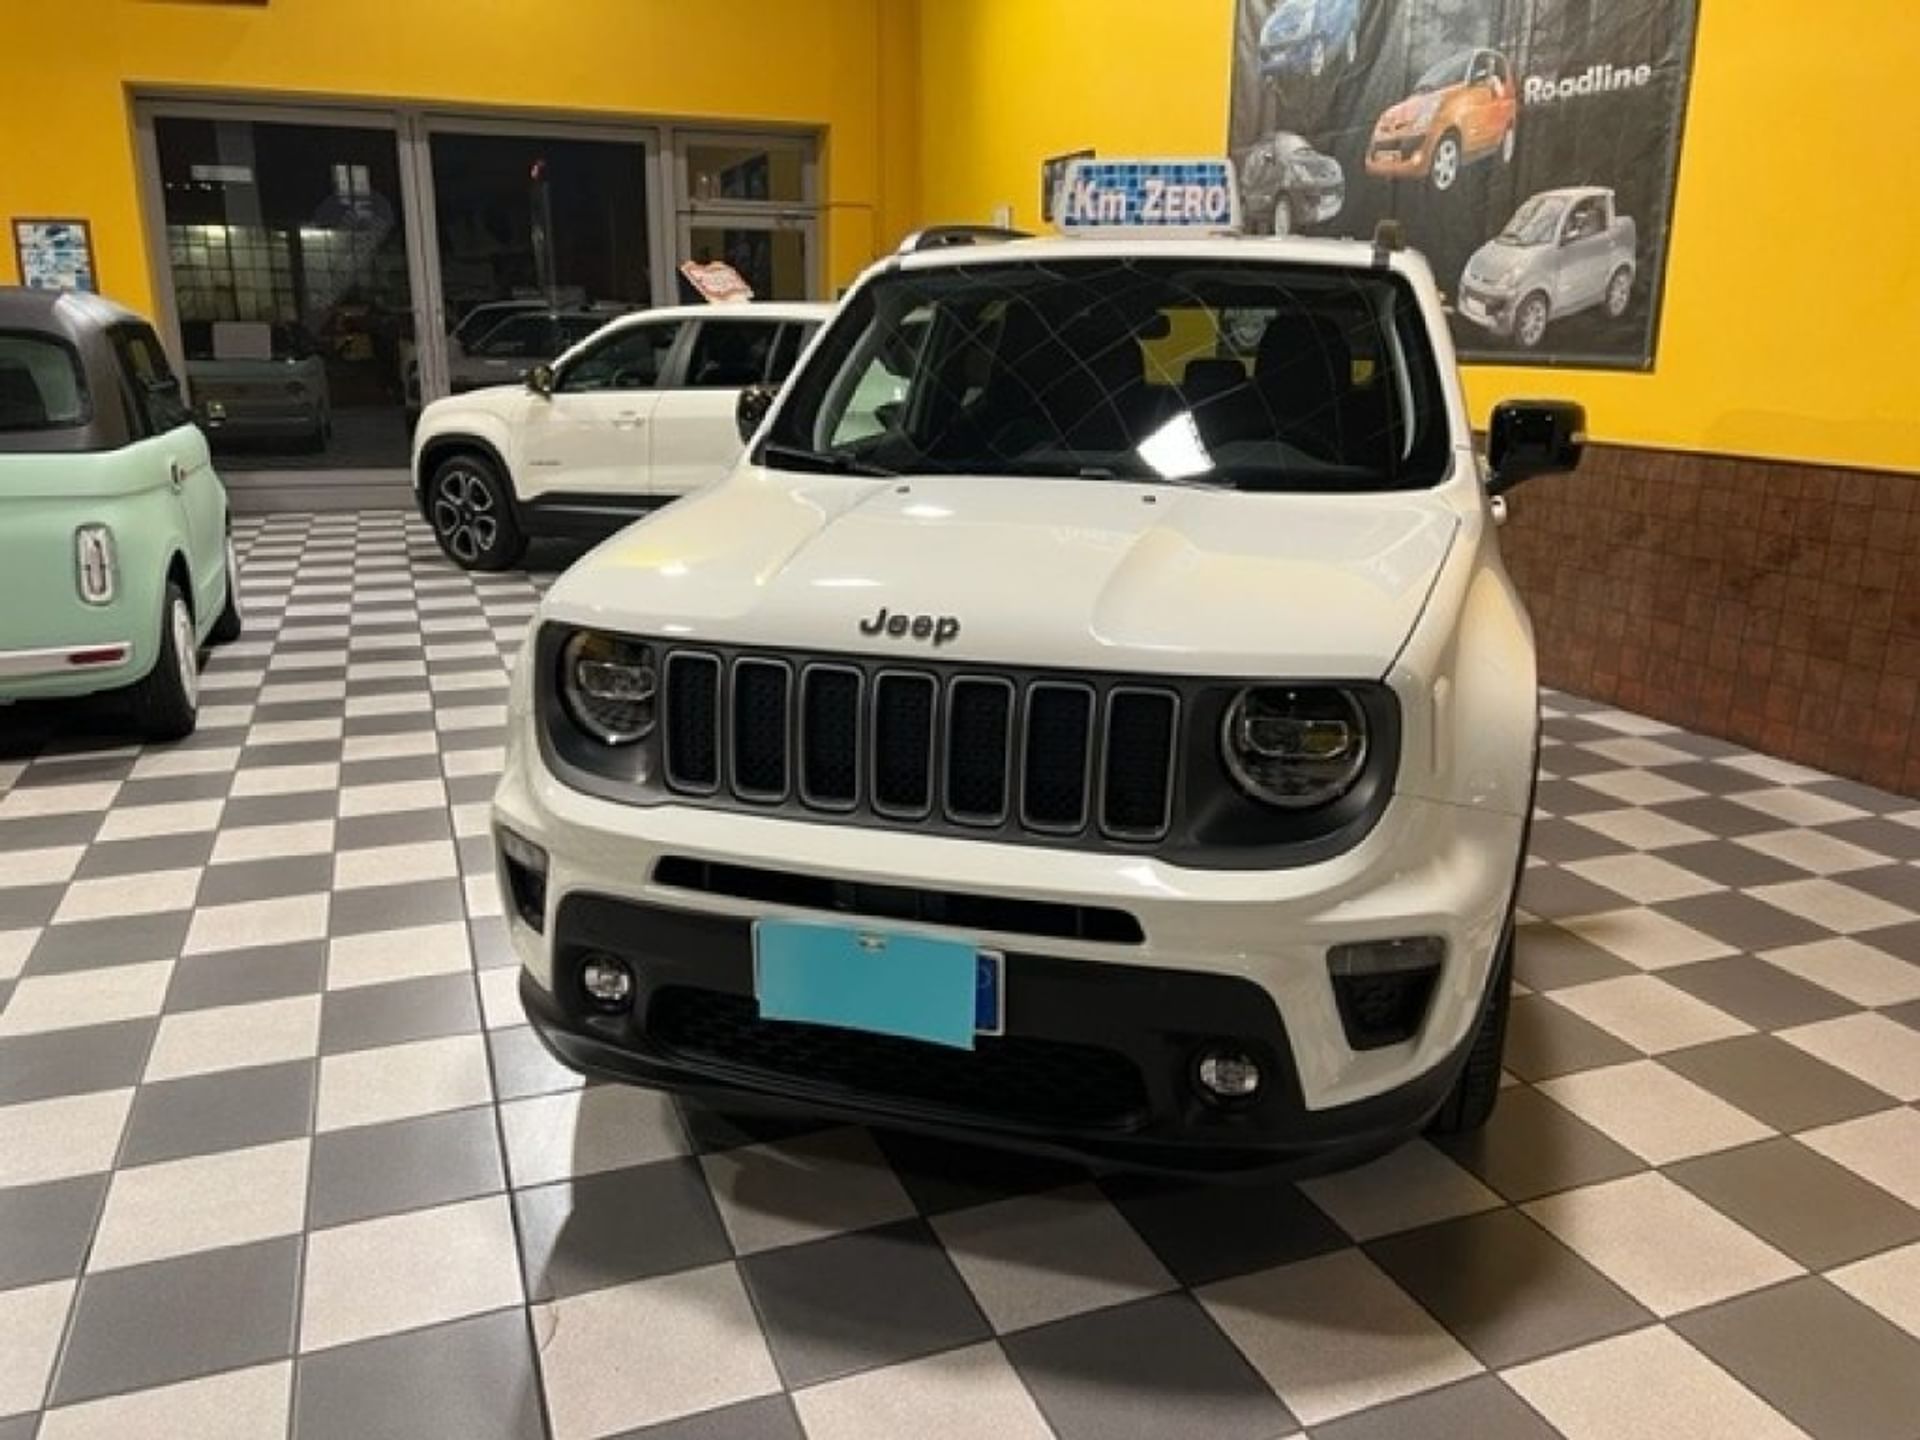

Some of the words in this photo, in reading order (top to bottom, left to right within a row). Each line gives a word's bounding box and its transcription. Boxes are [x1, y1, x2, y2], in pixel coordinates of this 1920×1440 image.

[1524, 63, 1652, 105] Roadline
[1073, 178, 1126, 221] Km
[1142, 179, 1227, 220] ZERO
[859, 606, 960, 647] Jeep
